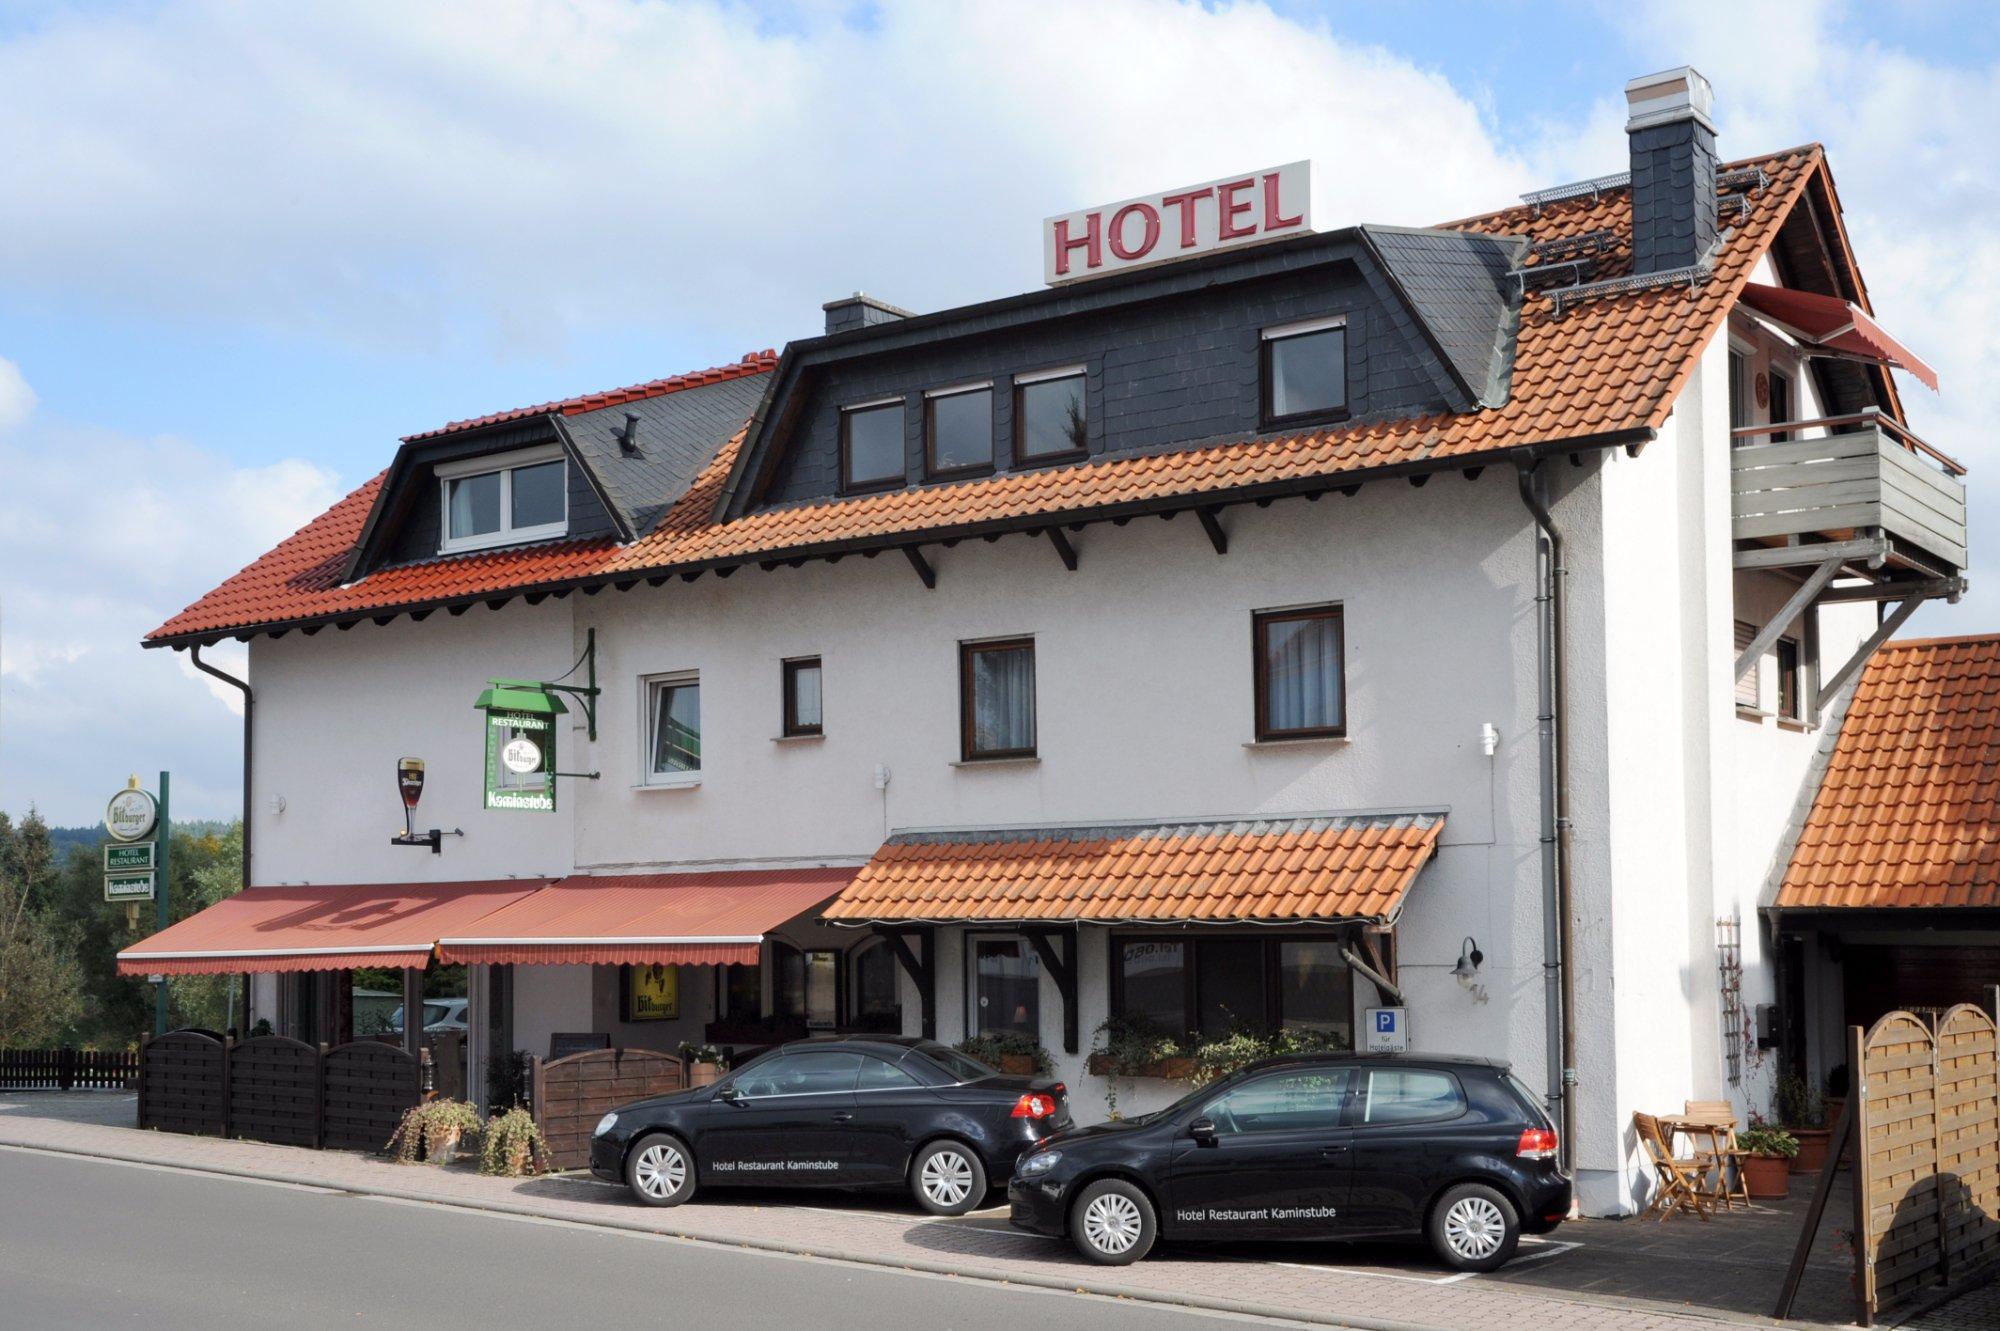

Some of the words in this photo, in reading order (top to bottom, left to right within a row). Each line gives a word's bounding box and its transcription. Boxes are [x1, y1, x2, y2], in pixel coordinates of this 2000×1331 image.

[1053, 171, 1304, 275] HOTEL
[492, 717, 549, 730] RESTAURANT
[507, 711, 536, 721] HOTEL
[488, 791, 554, 810] Kaminstube
[113, 806, 146, 825] Bitburger
[118, 848, 139, 857] HOTEL
[109, 856, 149, 866] RESTAURANT
[109, 879, 149, 894] Kaminstube
[1380, 1014, 1391, 1030] P
[712, 1161, 736, 1171] Hotel
[737, 1160, 785, 1171] Restaurant
[787, 1159, 839, 1170] Kaminstube
[1177, 1209, 1205, 1221] Hotel
[1209, 1207, 1268, 1221] Restaurant
[1271, 1206, 1336, 1219] Kaminstube
